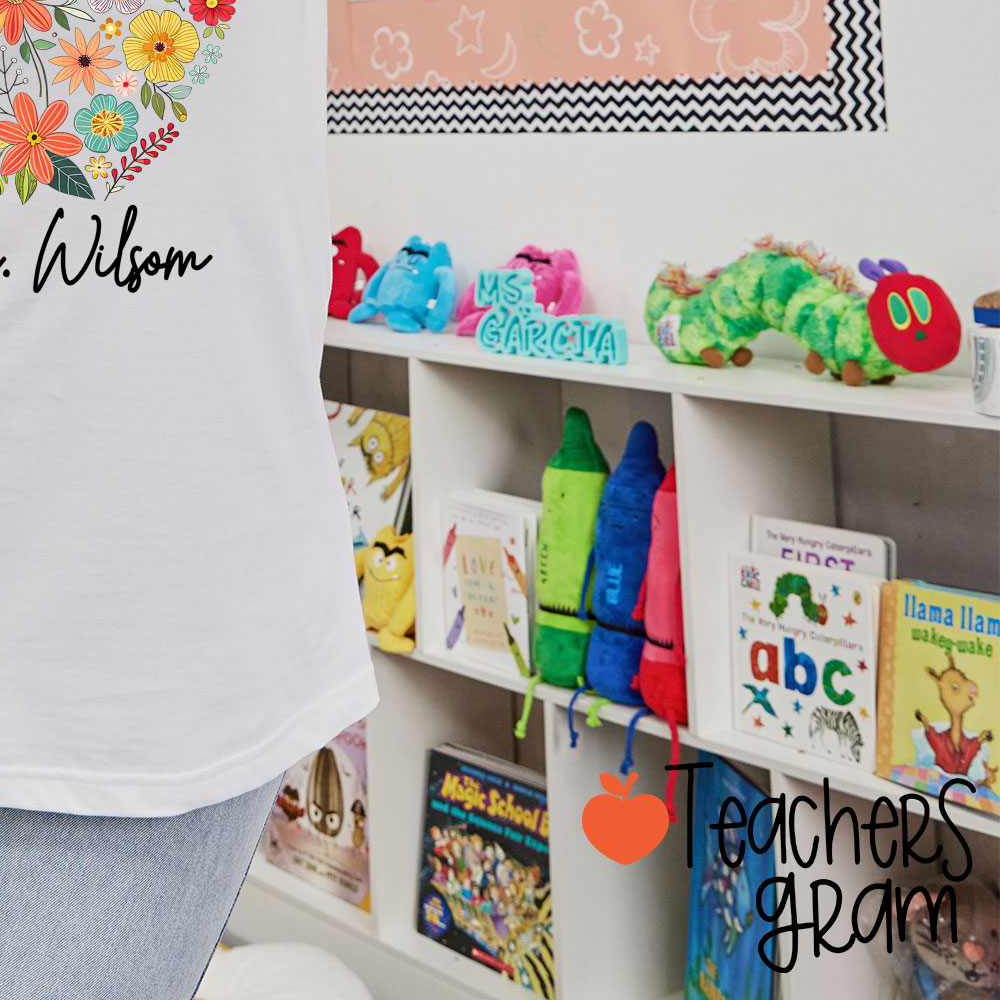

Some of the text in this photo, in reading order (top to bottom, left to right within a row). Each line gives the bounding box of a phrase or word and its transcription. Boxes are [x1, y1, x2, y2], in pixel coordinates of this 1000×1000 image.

[479, 310, 618, 365] GARCIA
[904, 593, 954, 627] llama
[911, 627, 993, 657] wakey-wake
[441, 772, 487, 811] Magic
[487, 788, 539, 832] School
